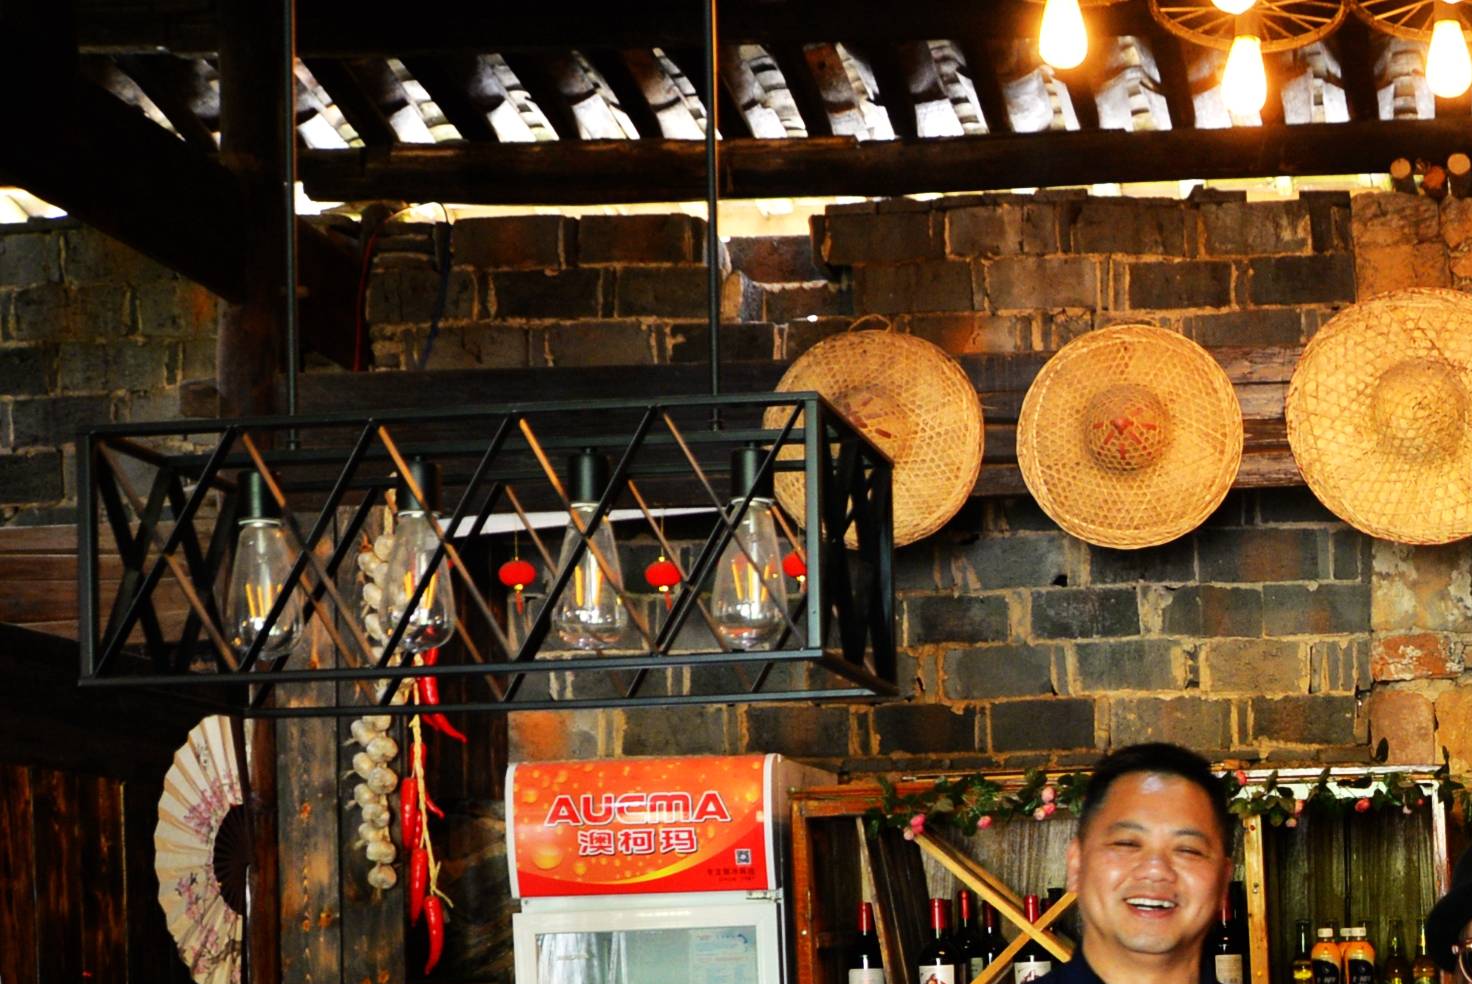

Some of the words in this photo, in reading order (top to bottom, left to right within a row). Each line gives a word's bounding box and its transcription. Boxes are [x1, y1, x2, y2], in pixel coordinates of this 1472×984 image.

[544, 790, 733, 828] AUCMA
[578, 828, 699, 856] 澳柯玛
